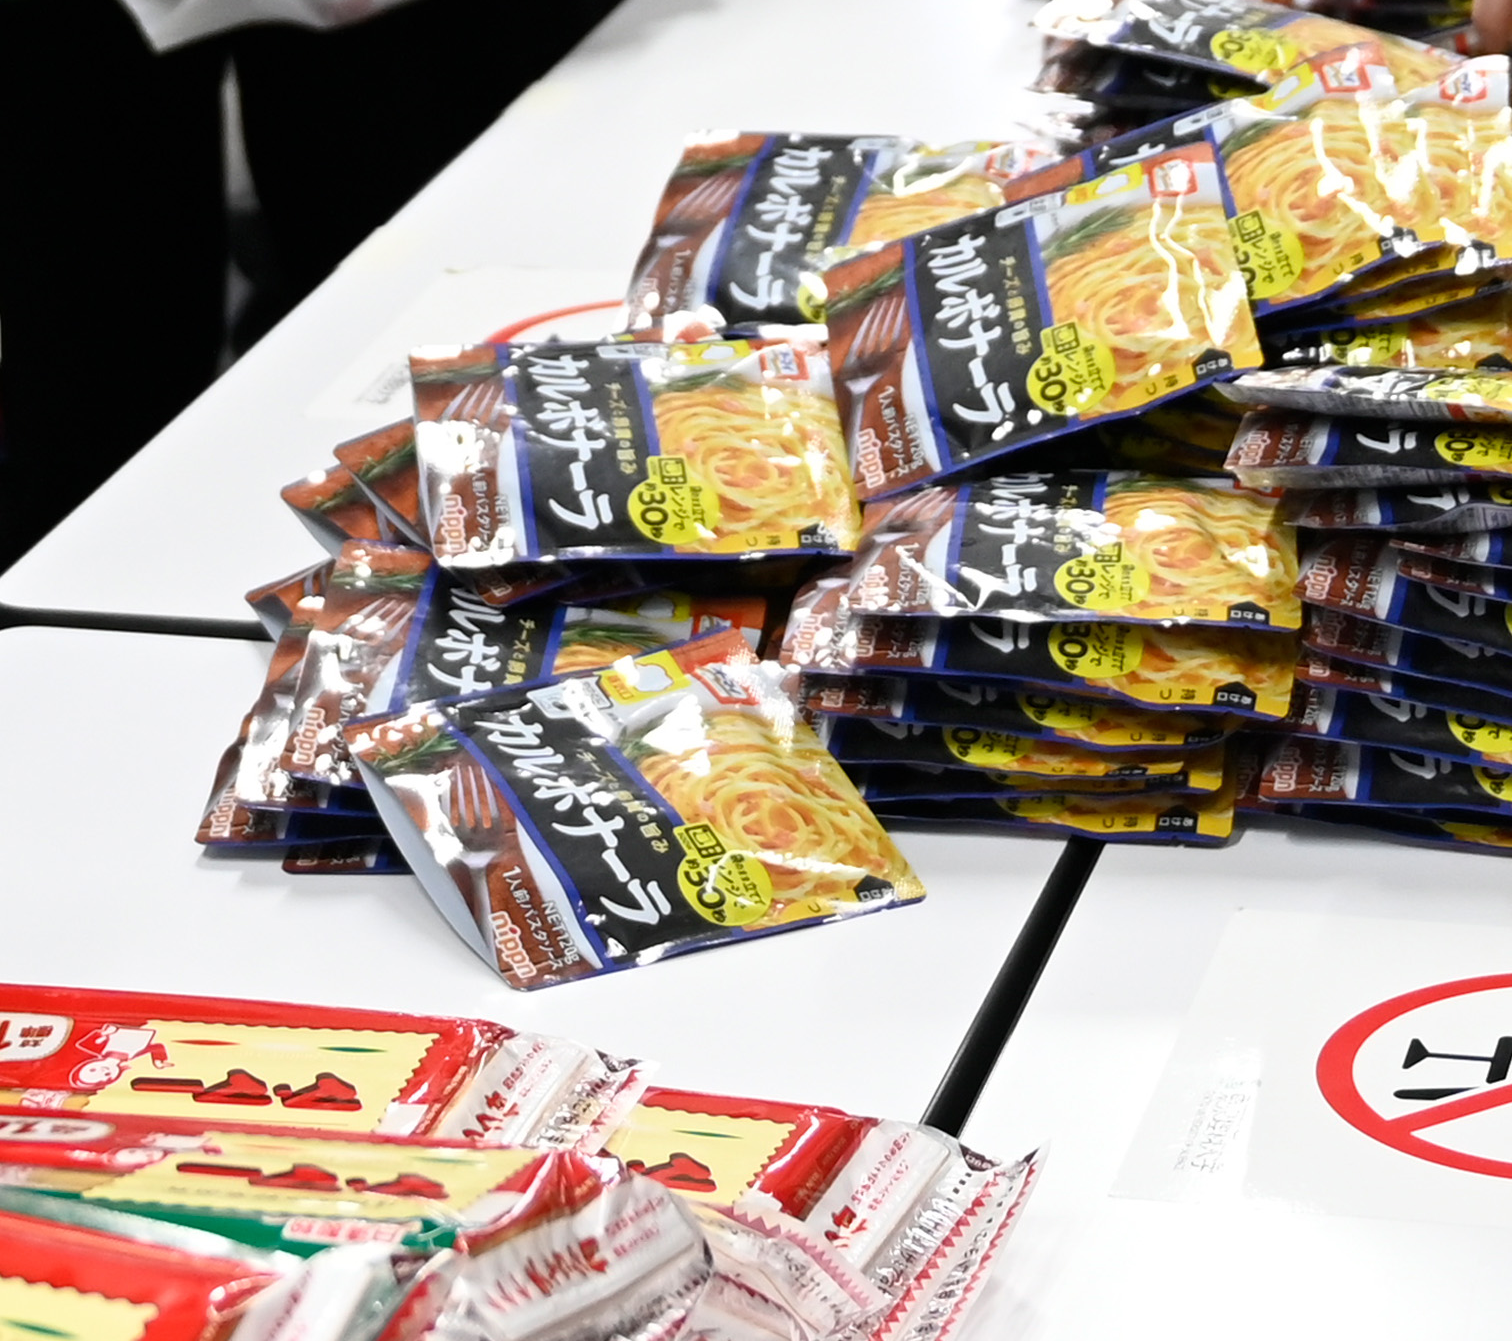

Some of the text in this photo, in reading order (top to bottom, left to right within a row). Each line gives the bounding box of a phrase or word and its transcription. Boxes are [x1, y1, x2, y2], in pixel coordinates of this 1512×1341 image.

[730, 146, 833, 309] カルボナーラ
[927, 233, 1015, 424] カルボナーラ
[527, 355, 613, 530] カルボナーラ
[857, 428, 886, 489] nippn
[442, 494, 469, 553] nippn
[638, 482, 669, 539] 約30秒
[670, 486, 687, 531] レンジで
[1305, 555, 1337, 600] nippn
[1160, 688, 1196, 700] 持つ
[1217, 692, 1252, 705] あけ口
[293, 707, 325, 765] nippn
[484, 710, 672, 925] カルボナーラ
[488, 910, 537, 979] nippn
[502, 865, 563, 970] 1人前パスタソース
[131, 1069, 362, 1111] マ・マー
